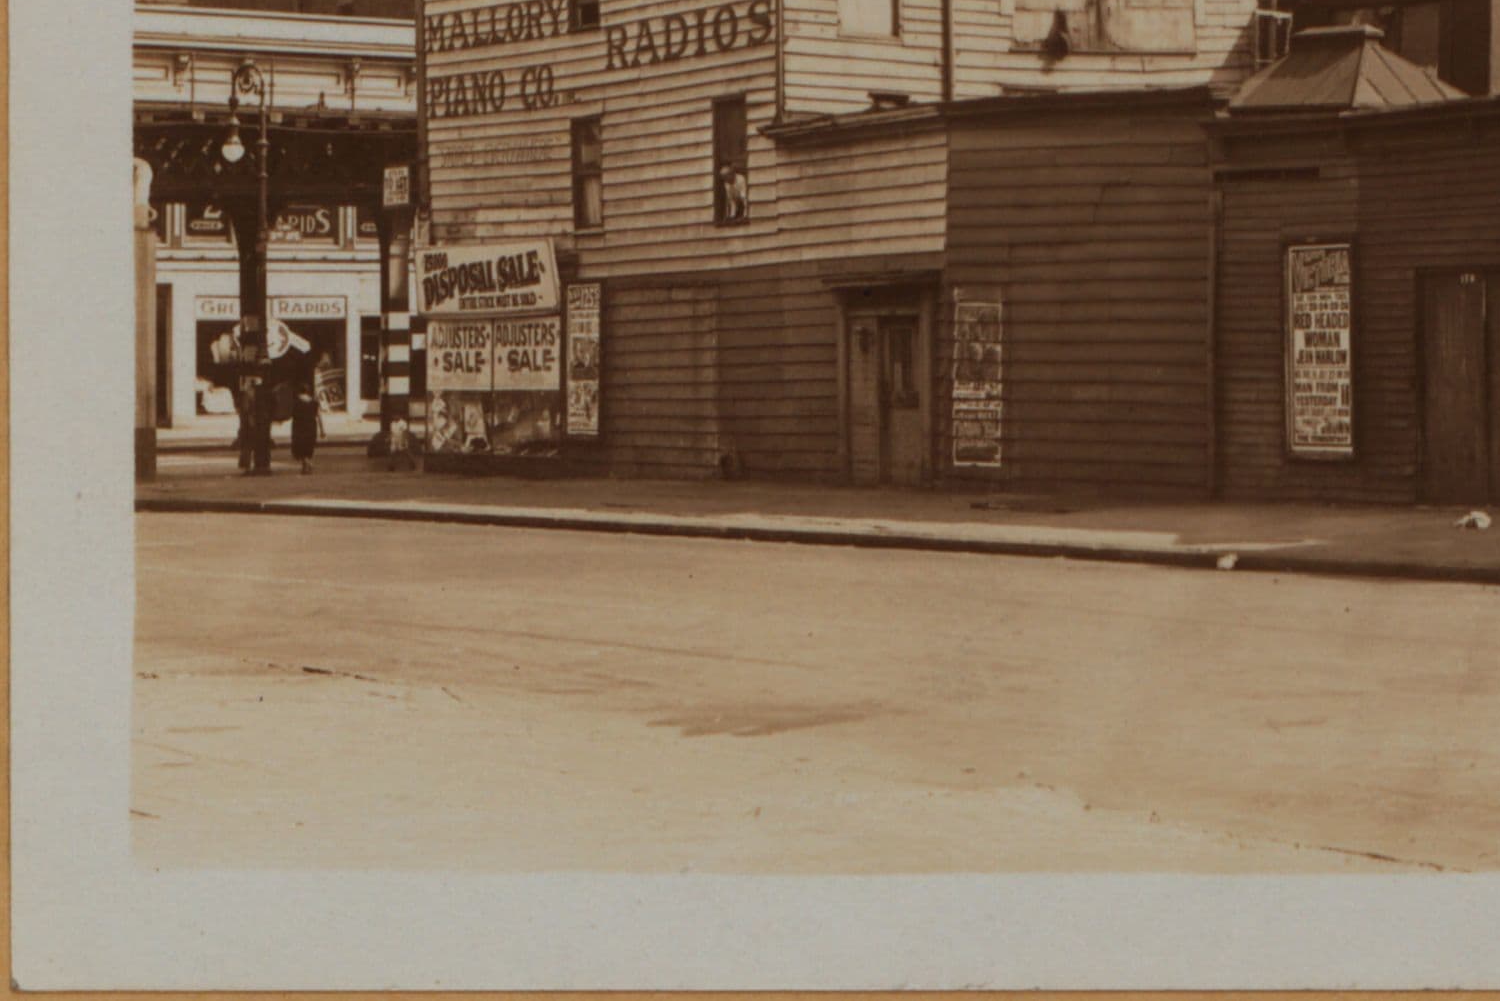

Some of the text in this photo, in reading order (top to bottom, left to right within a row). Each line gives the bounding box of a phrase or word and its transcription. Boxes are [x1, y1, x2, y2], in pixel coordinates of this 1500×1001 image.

[429, 71, 505, 118] PIANO
[275, 209, 330, 233] APIDS
[497, 249, 541, 292] SALE
[278, 300, 341, 314] RAPIDS
[1294, 313, 1311, 329] RED
[431, 325, 486, 348] ADJUSTERS
[494, 323, 555, 348] ADJUSTERS
[443, 351, 485, 373] SALE
[507, 349, 555, 373] SALE
